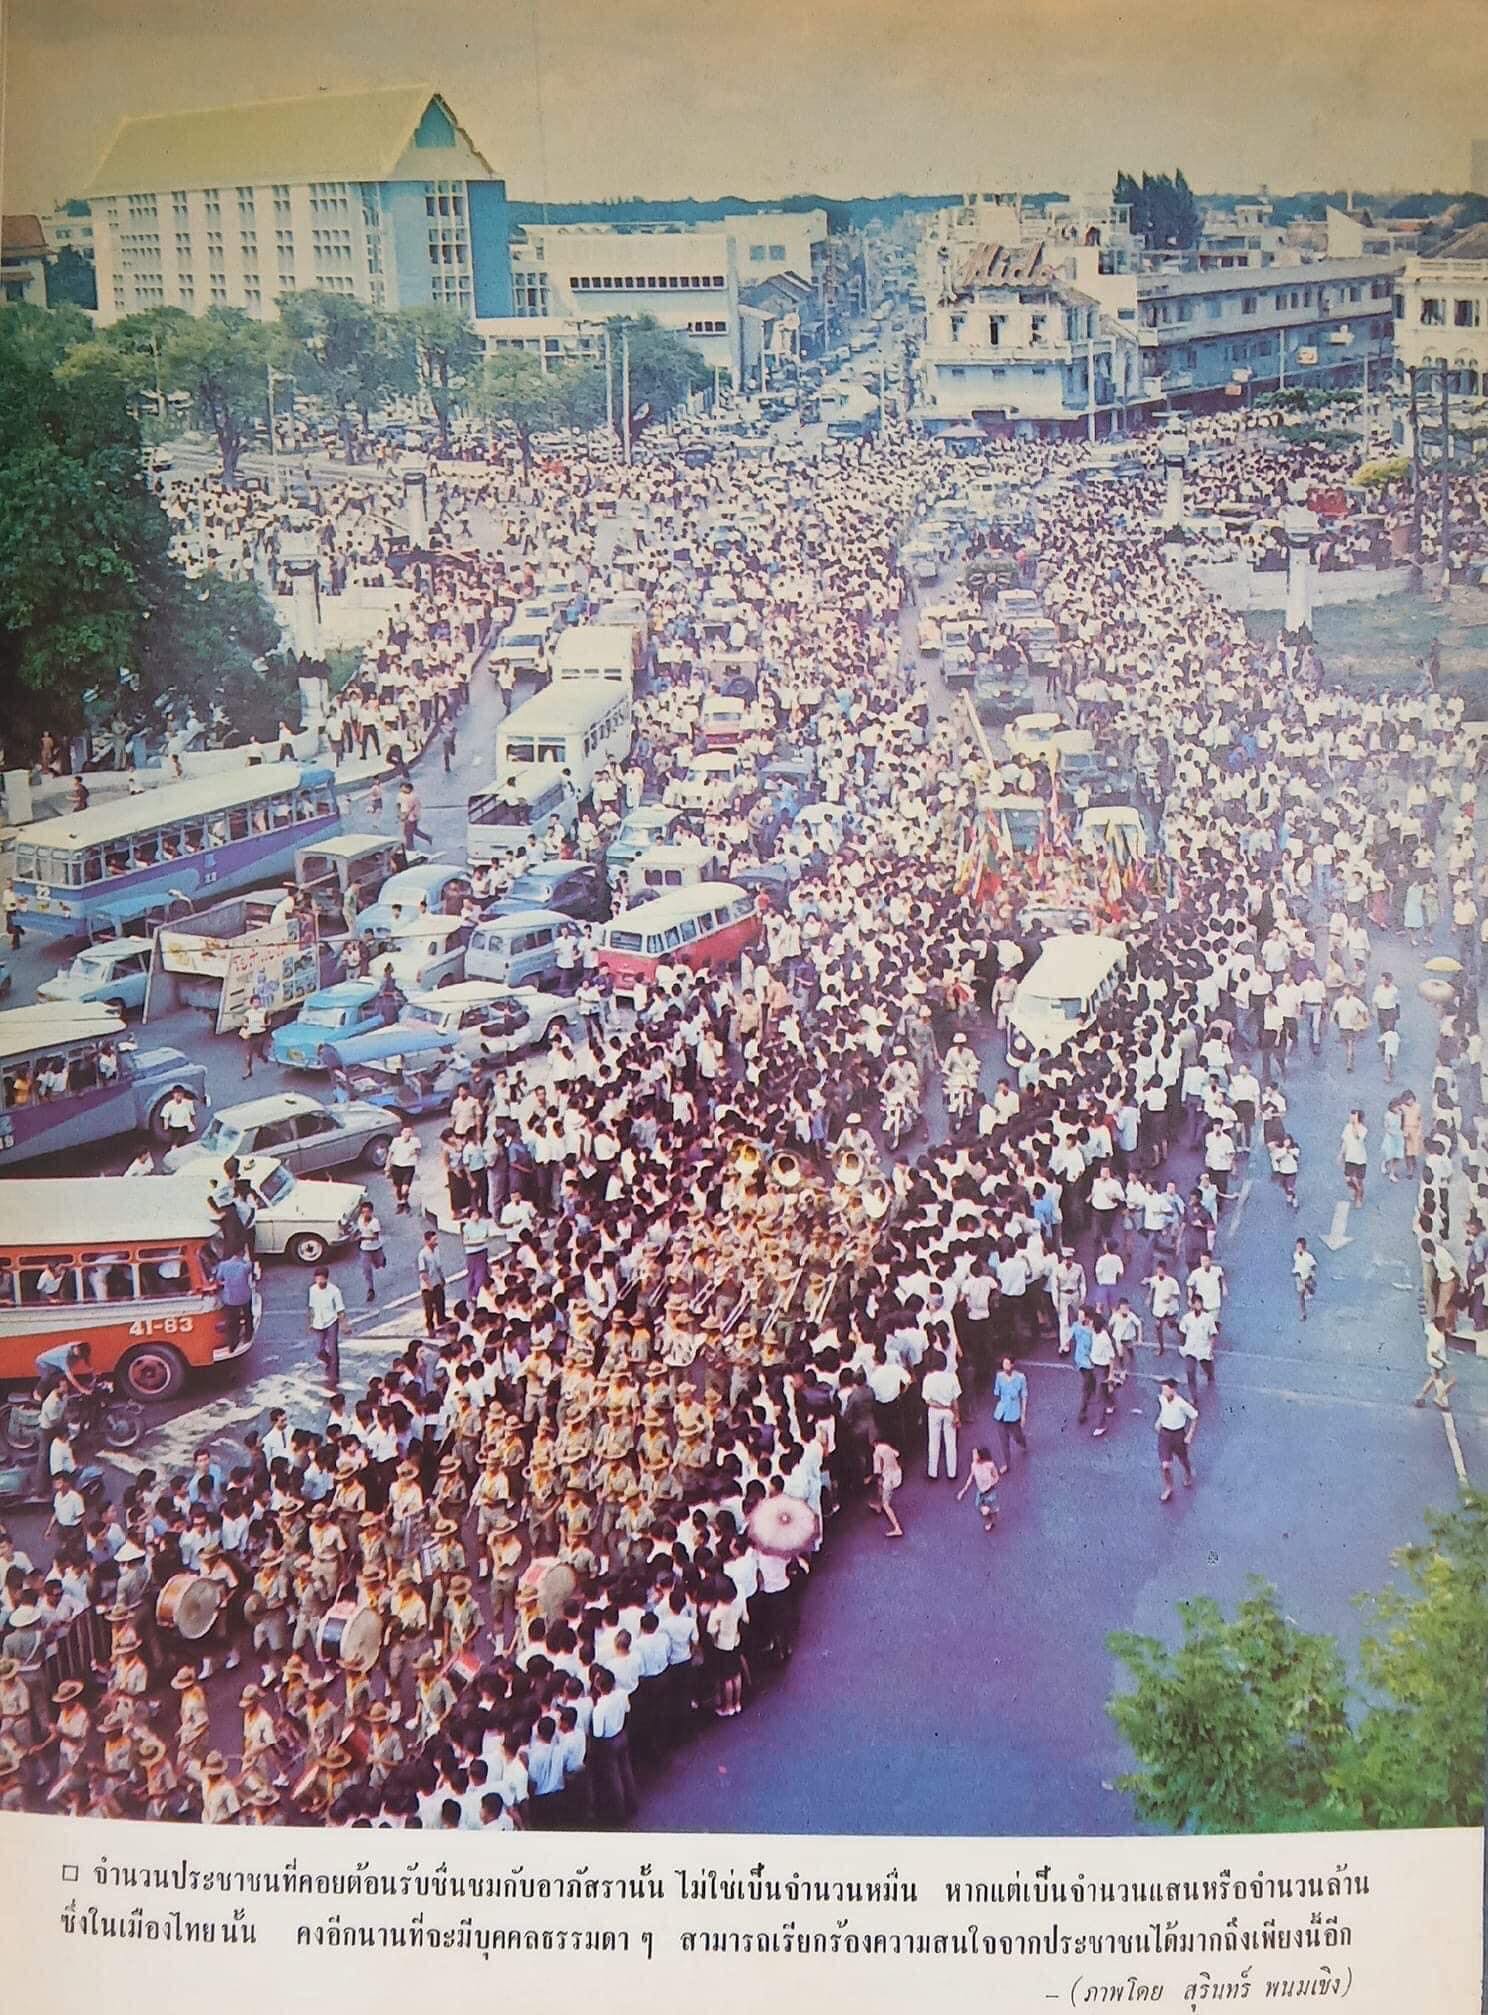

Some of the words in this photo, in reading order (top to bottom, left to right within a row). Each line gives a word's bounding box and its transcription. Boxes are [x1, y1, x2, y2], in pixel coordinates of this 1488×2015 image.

[961, 240, 1054, 285] Mido
[129, 1316, 193, 1336] 41-83
[1184, 1965, 1254, 2012] สุรินทร์
